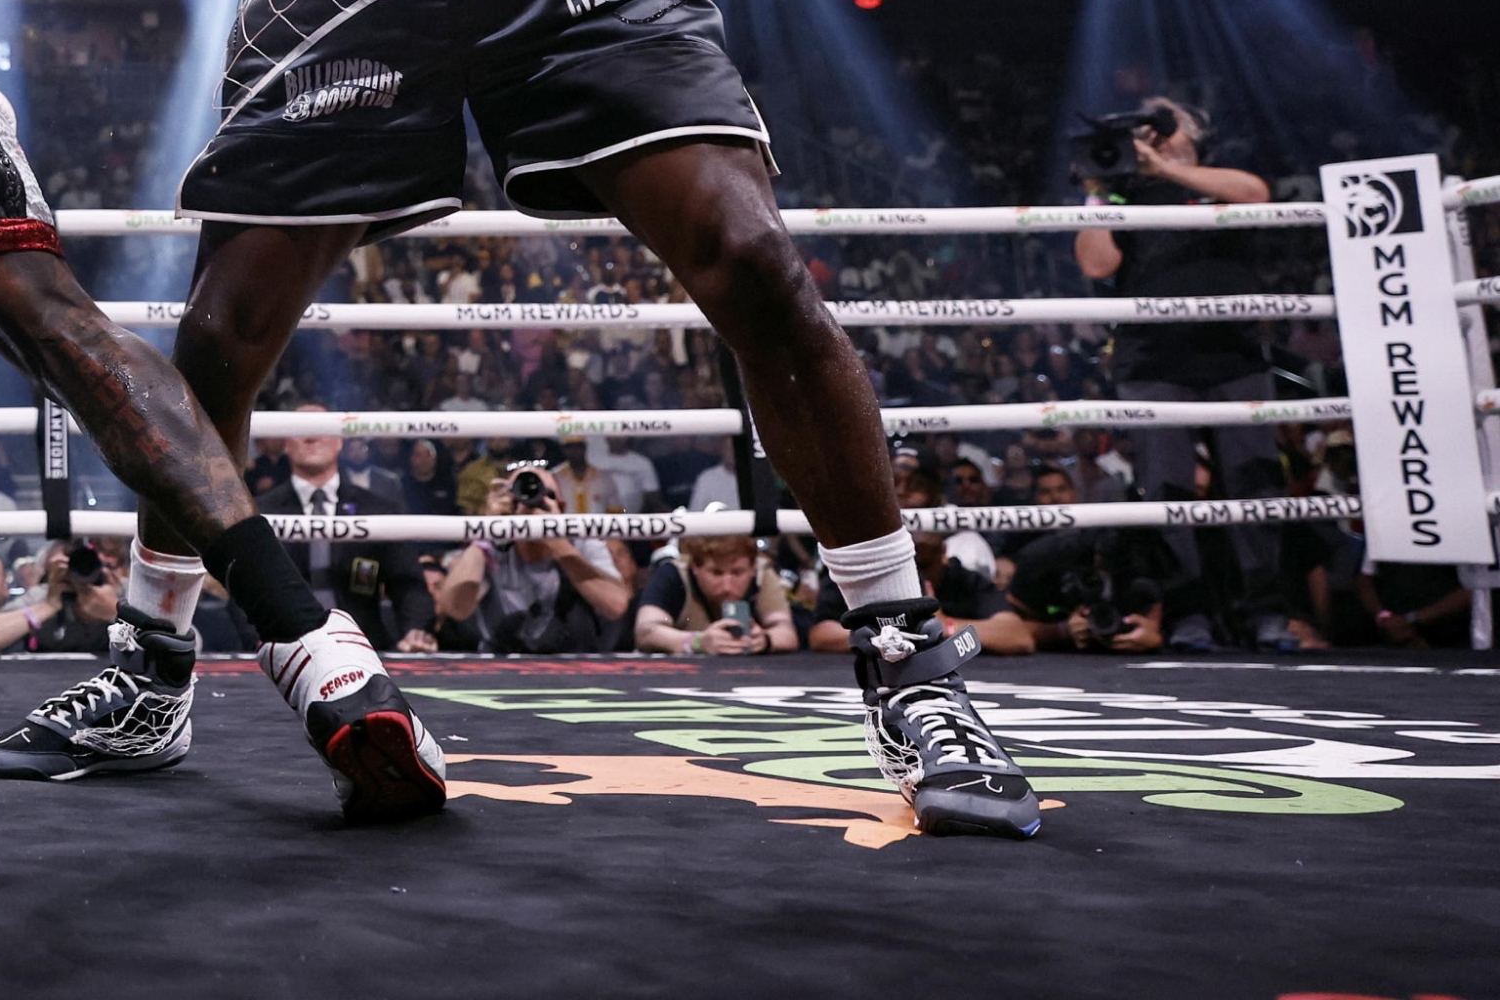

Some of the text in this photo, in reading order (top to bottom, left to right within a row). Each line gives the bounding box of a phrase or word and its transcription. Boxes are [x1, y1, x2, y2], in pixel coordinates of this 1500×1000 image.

[284, 58, 403, 105] BILLIONAIRE
[311, 87, 396, 117] BOYS CLUB
[457, 303, 639, 320] MGM REWARDS
[835, 299, 1015, 317] MGM REWARDS
[1135, 297, 1312, 316] MGM REWARDS
[1374, 243, 1442, 548] MGM REWARDS
[50, 405, 64, 479] AMPIONS
[932, 506, 1075, 529] REWARDS
[1166, 497, 1361, 524] MGM REWARD
[273, 519, 370, 539] WARDS
[463, 517, 686, 539] MGM REWARDS
[876, 612, 908, 628] EVERLAST
[953, 631, 976, 657] BUD
[319, 669, 366, 700] SEASON
